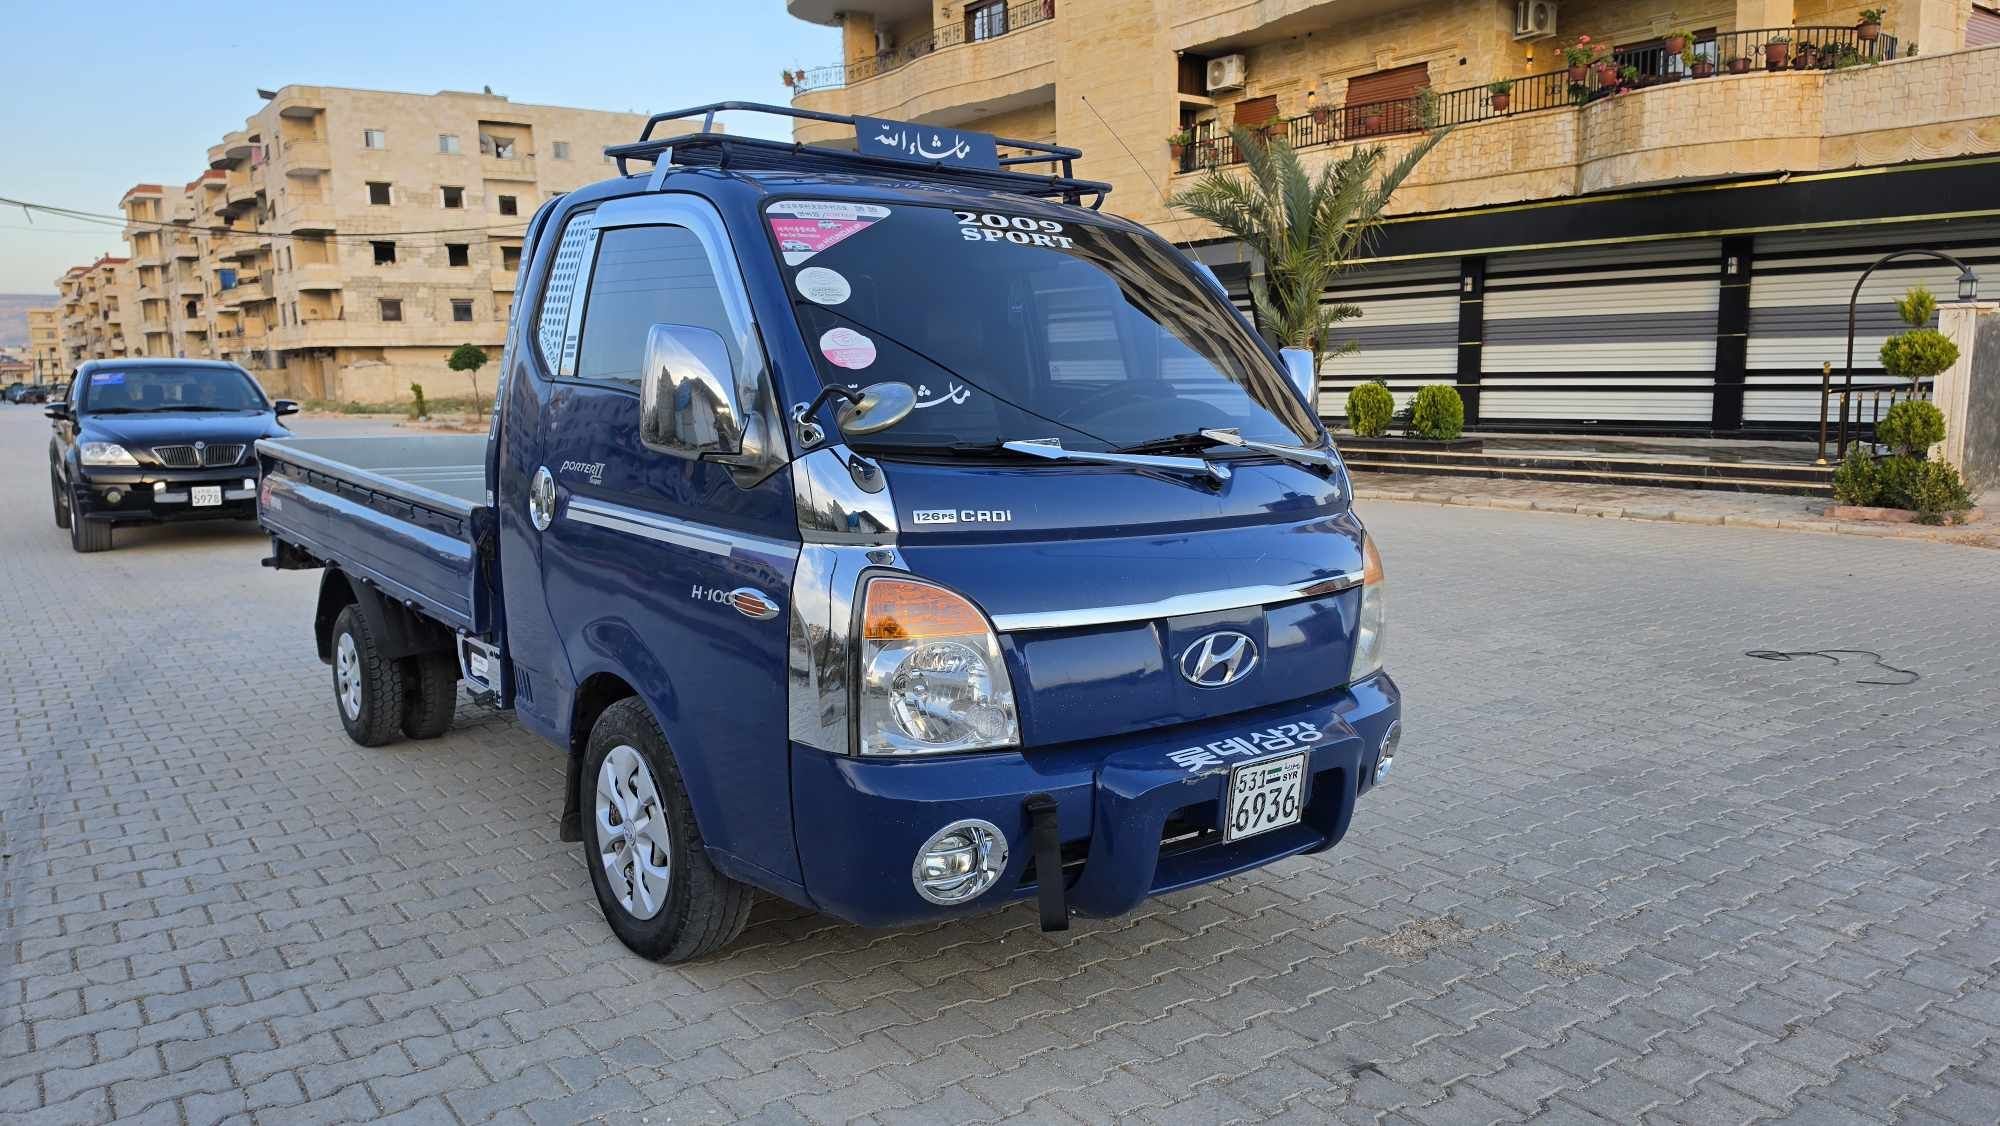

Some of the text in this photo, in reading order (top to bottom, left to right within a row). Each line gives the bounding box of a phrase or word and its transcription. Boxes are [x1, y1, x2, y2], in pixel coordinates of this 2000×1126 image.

[874, 123, 907, 150] الله
[954, 211, 1063, 233] 2009
[961, 227, 1073, 249] SPORT
[1165, 721, 1324, 773] 롯데삼강
[1238, 769, 1266, 794] 531
[1282, 770, 1298, 782] SYR
[1235, 783, 1296, 832] 6936
